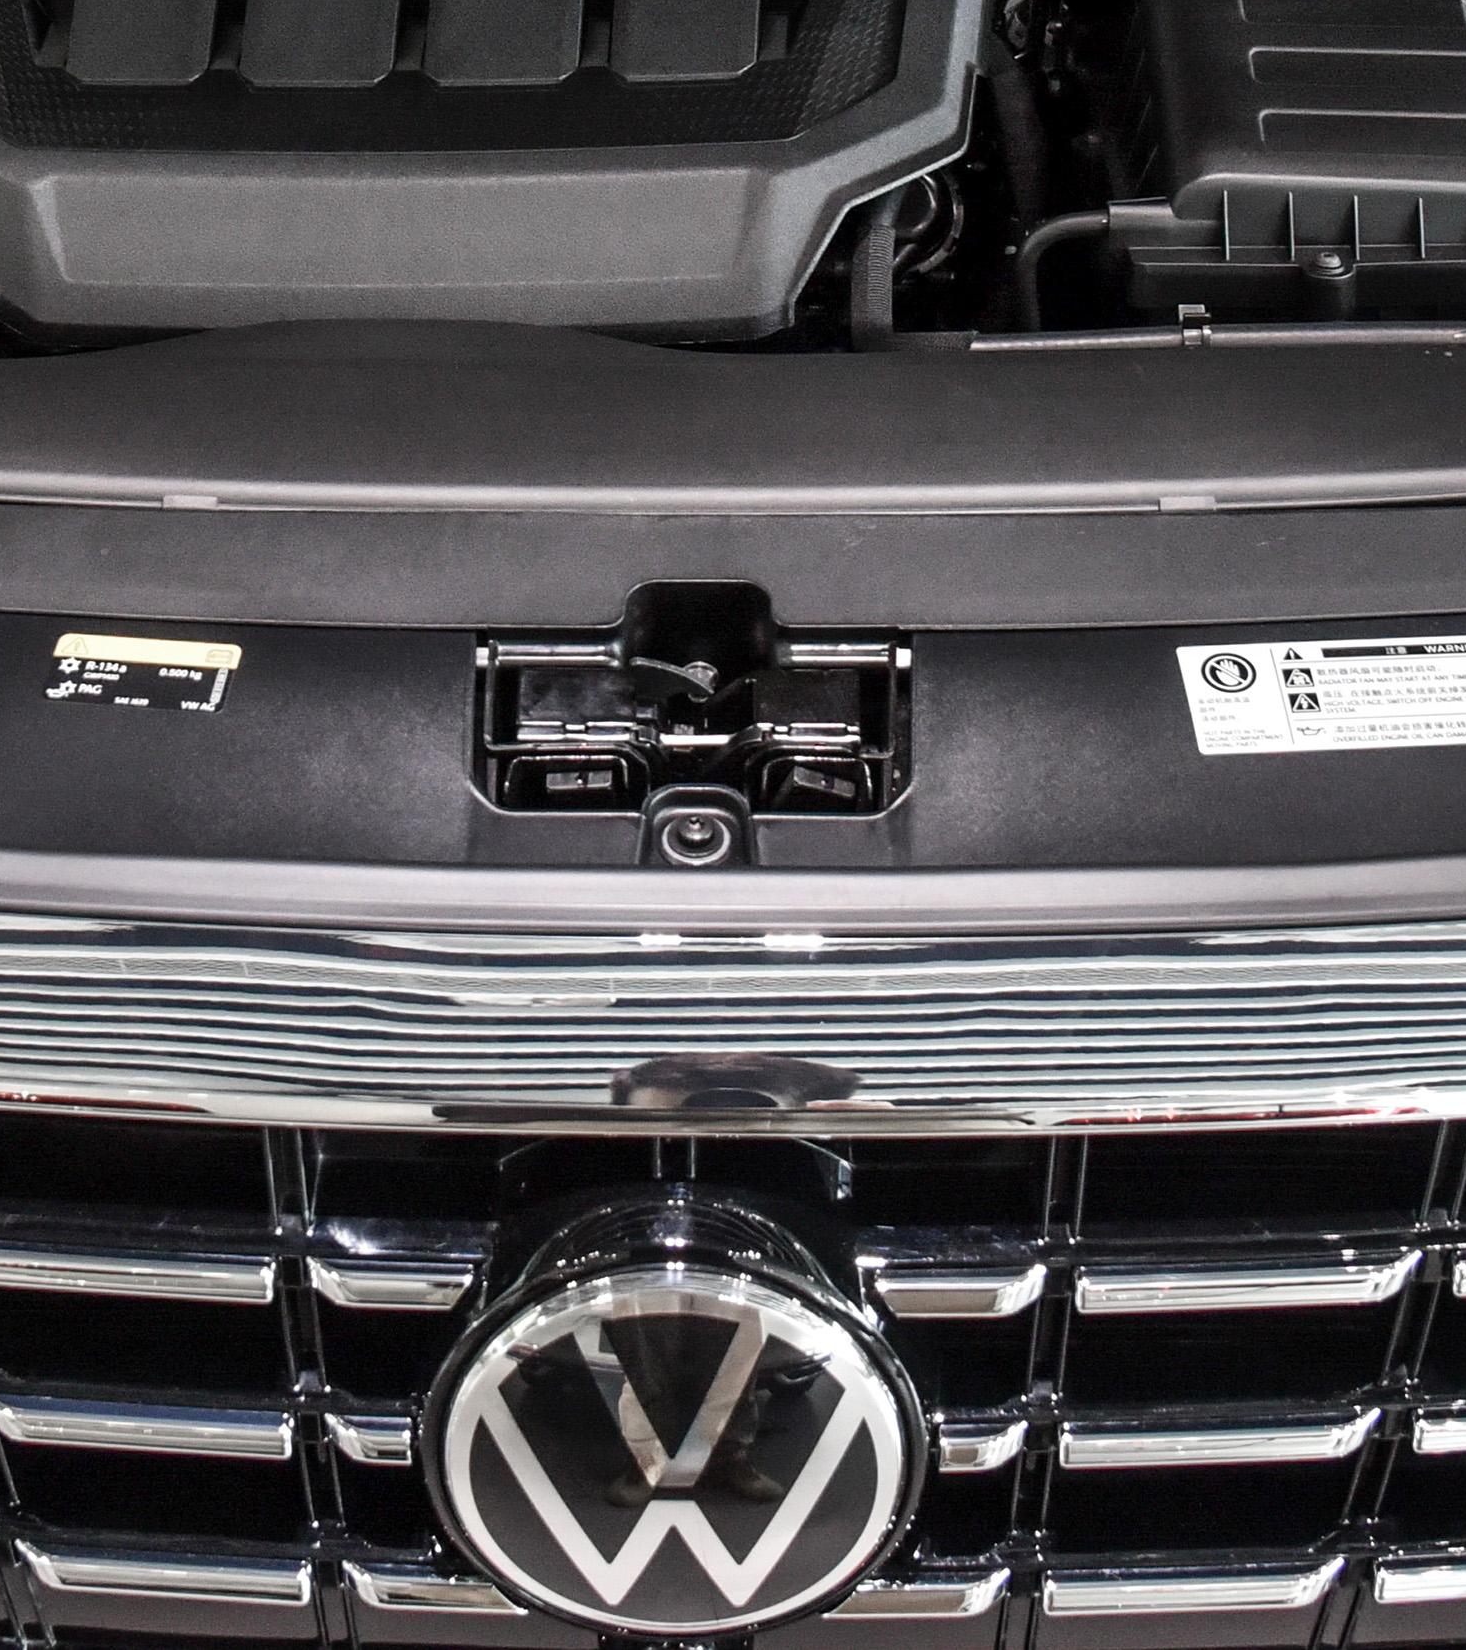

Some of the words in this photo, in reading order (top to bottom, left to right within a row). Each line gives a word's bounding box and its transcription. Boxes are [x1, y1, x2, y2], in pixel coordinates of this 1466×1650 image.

[158, 667, 188, 678] 0.500
[189, 669, 203, 681] kg
[1318, 678, 1358, 686] RADIATOR
[78, 683, 103, 695] PAG
[180, 700, 199, 711] VW
[199, 701, 216, 712] AG
[1386, 697, 1417, 705] SWITCH
[461, 1290, 883, 1620] VW
